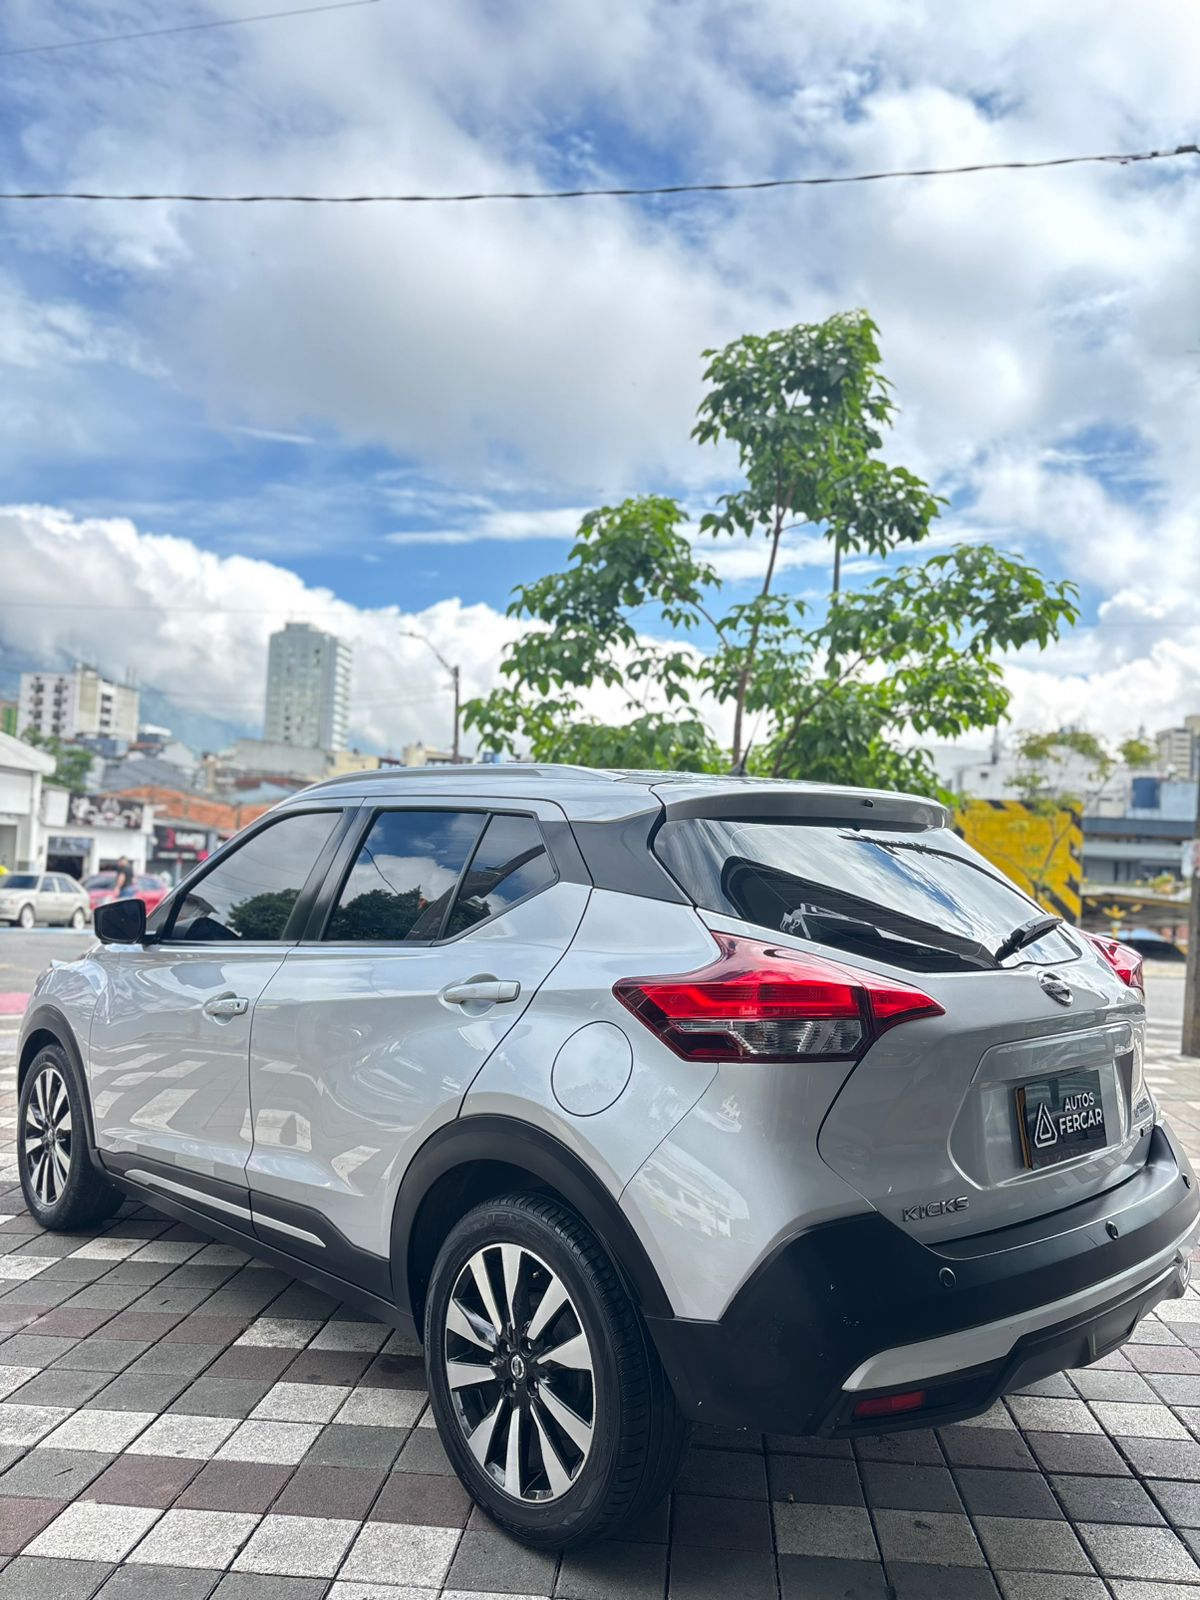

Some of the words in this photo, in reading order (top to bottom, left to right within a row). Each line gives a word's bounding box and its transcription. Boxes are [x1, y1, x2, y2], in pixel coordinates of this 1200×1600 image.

[1064, 1092, 1095, 1112] AUTOS
[1059, 1108, 1103, 1135] FERCAR
[903, 1195, 970, 1222] KICKS
